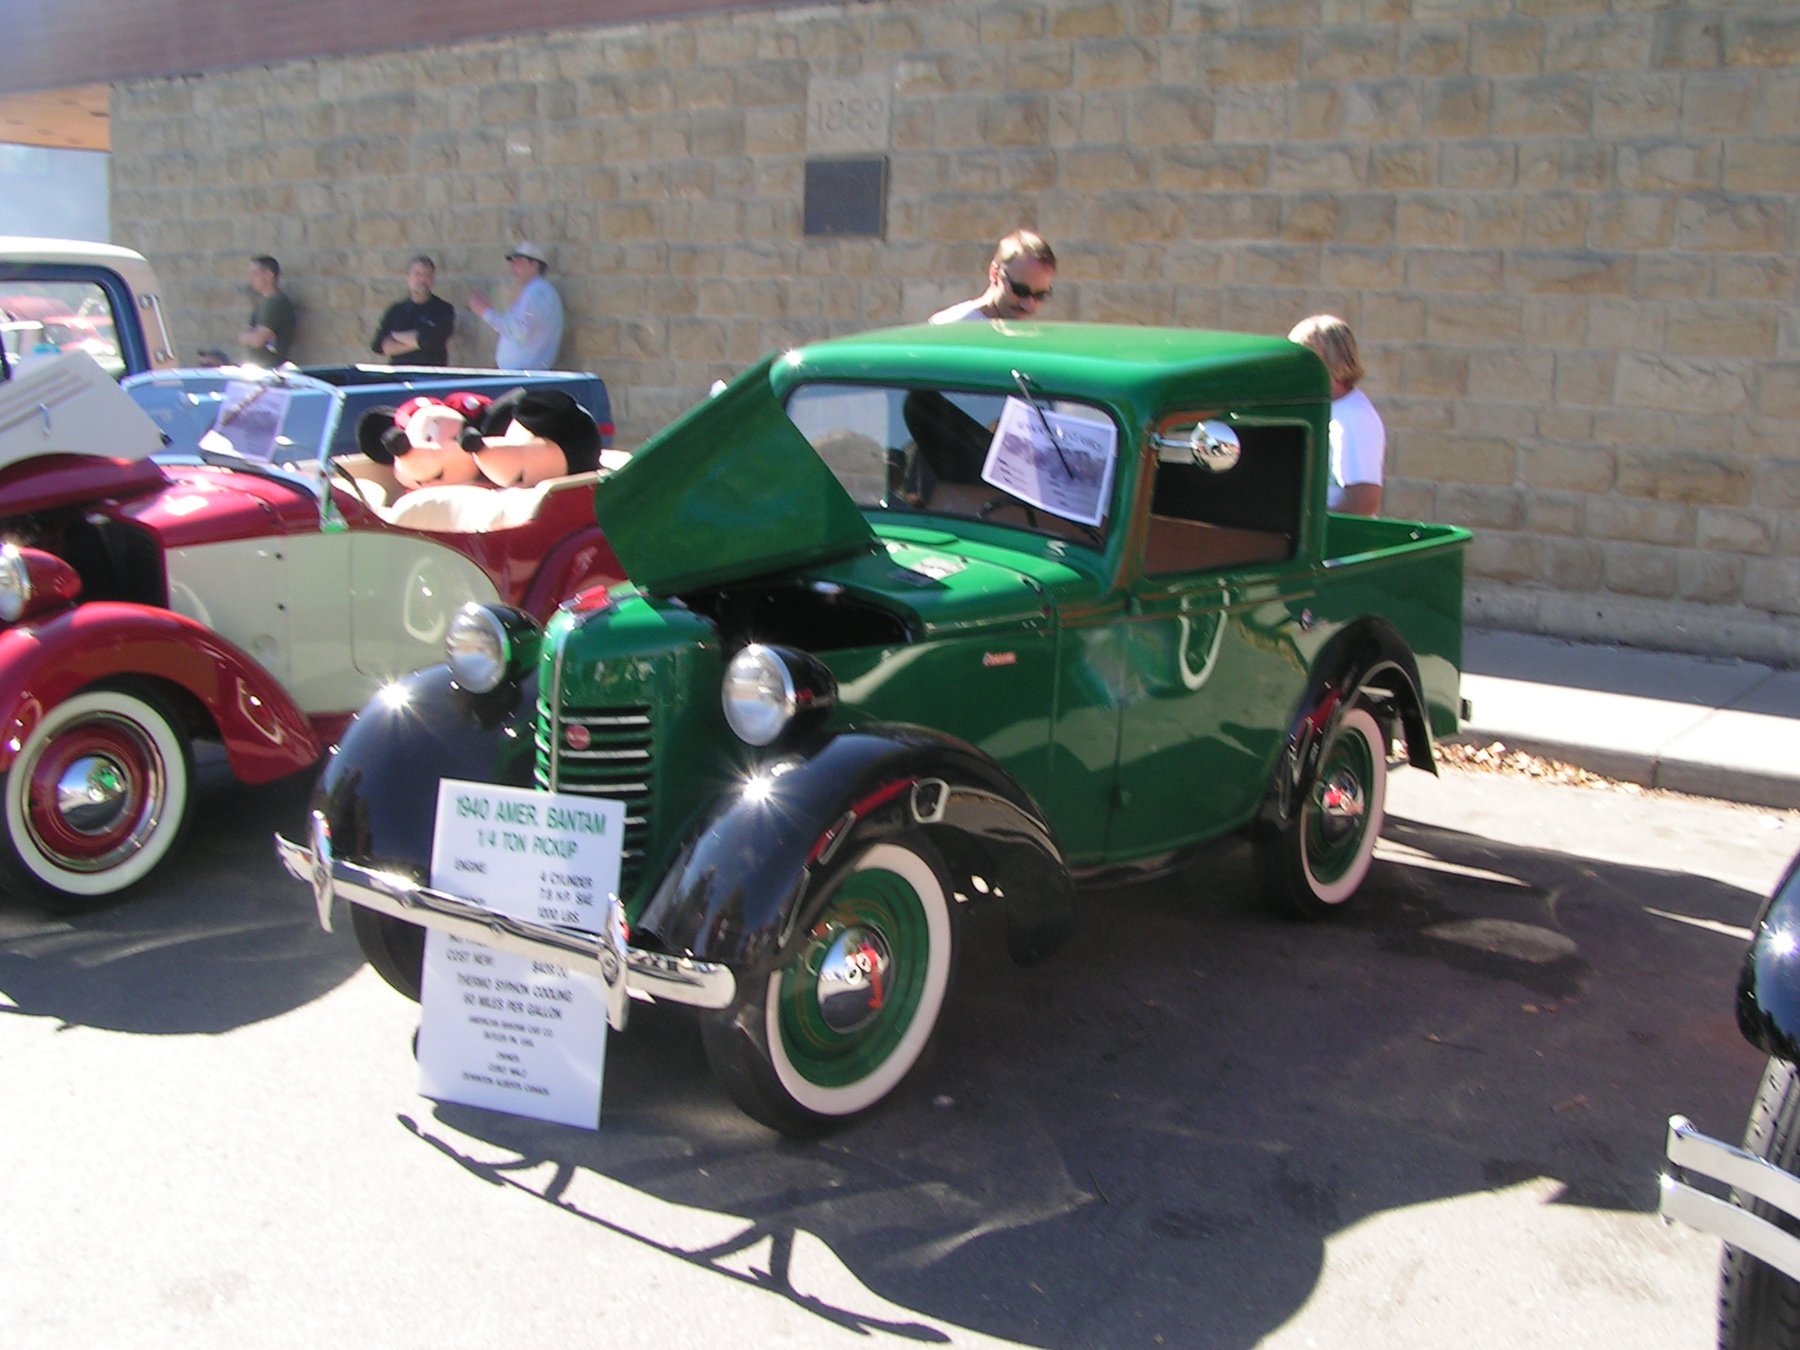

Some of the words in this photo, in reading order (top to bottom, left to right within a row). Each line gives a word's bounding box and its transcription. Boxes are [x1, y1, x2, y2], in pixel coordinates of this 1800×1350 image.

[456, 796, 489, 819] 1940
[547, 806, 606, 836] BANTAM
[503, 831, 528, 853] TON
[533, 836, 579, 860] PICKUP
[550, 873, 594, 889] CYLINDER
[531, 985, 573, 1003] COOLING
[478, 995, 504, 1012] MILES
[507, 1000, 525, 1014] PER
[527, 1004, 563, 1020] GALLON
